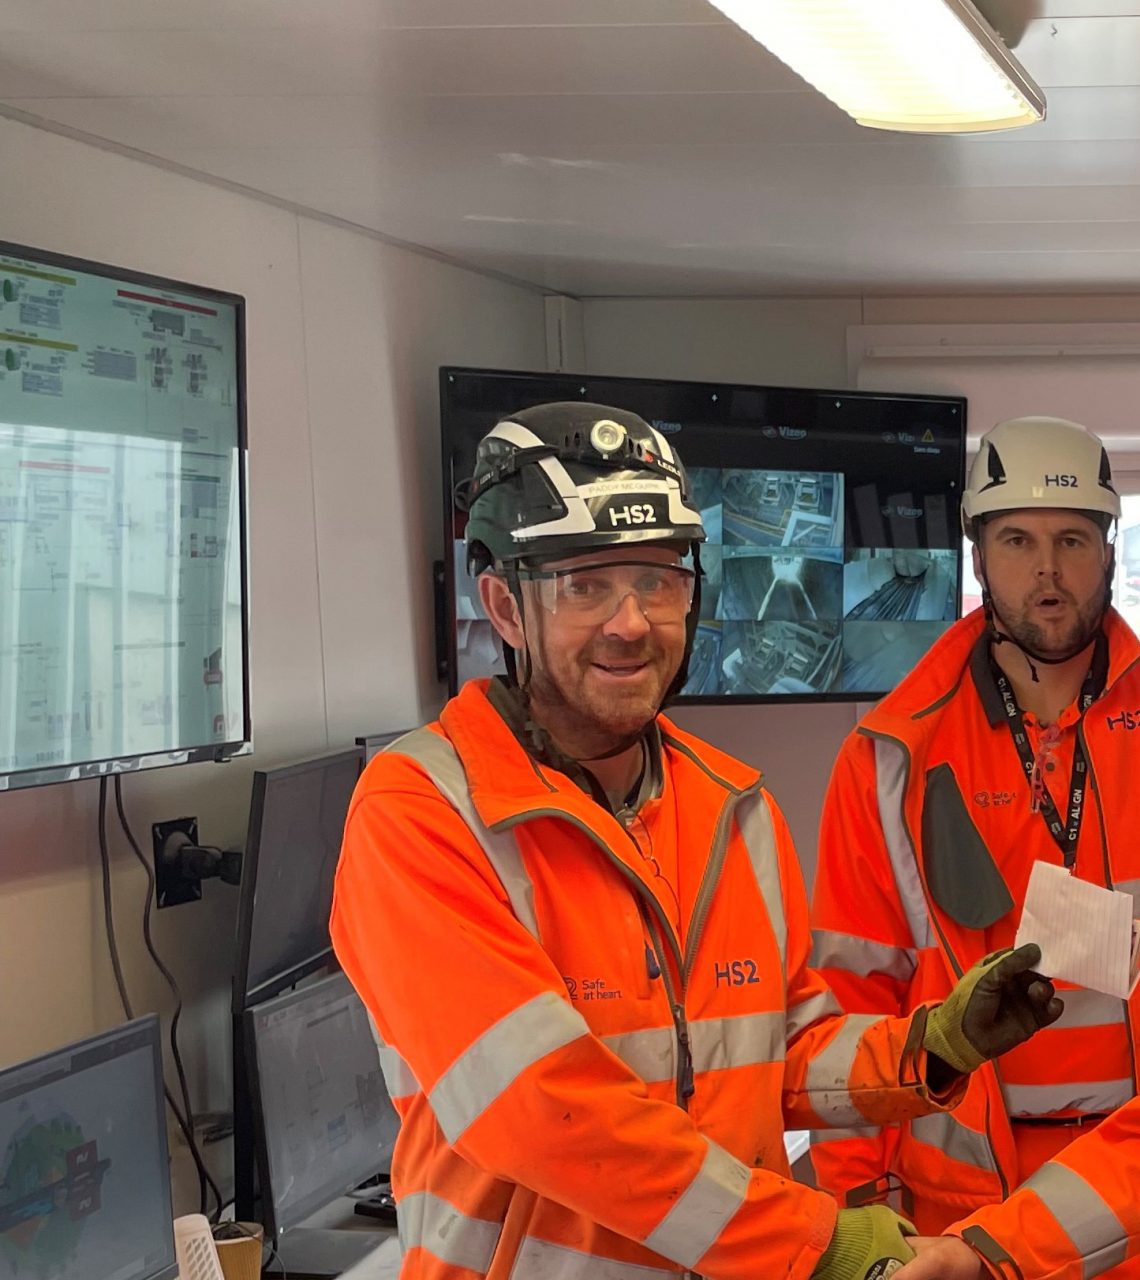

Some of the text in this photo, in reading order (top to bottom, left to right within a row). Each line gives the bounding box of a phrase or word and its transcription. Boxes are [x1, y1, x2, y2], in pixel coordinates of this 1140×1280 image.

[1045, 474, 1079, 488] HS2
[609, 503, 657, 527] HS2
[715, 960, 760, 988] HS2
[582, 979, 606, 993] Safe
[583, 988, 622, 1000] at heart
